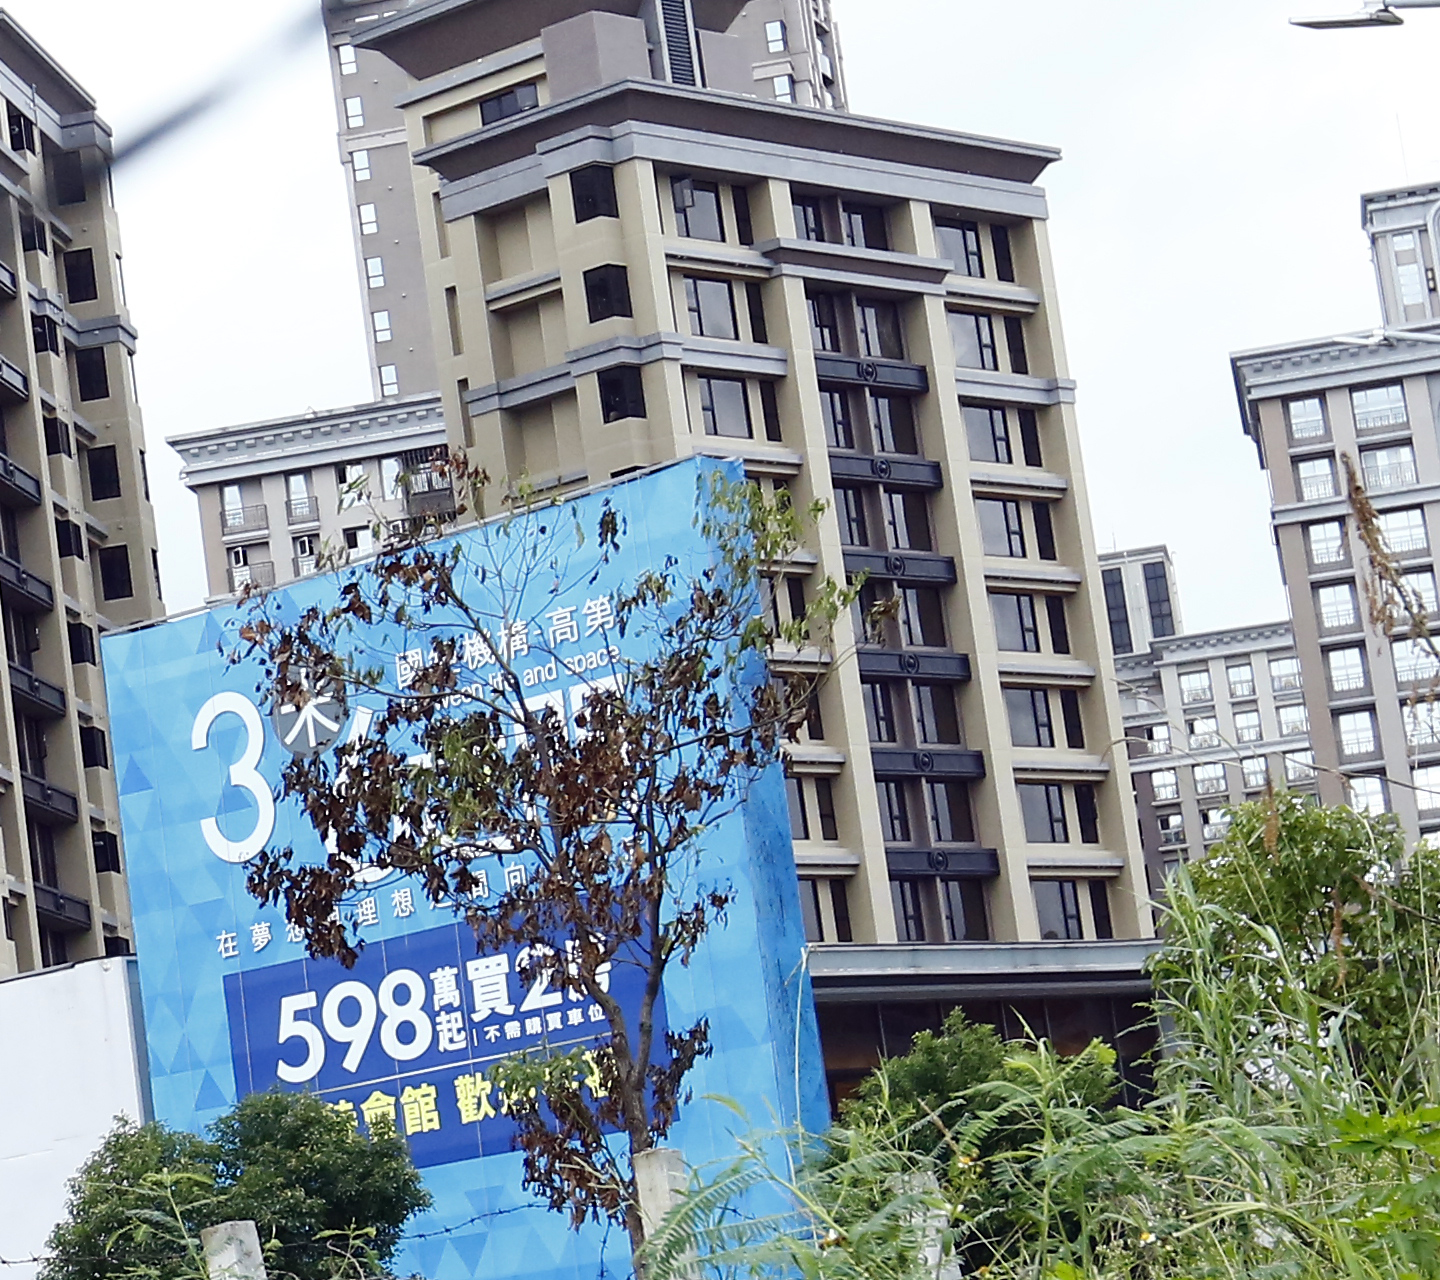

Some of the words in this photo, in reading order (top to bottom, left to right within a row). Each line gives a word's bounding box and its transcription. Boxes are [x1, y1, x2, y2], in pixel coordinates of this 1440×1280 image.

[523, 655, 557, 687] and
[564, 644, 620, 676] space
[276, 969, 433, 1083] 598
[485, 1003, 606, 1044] 不需購買車位
